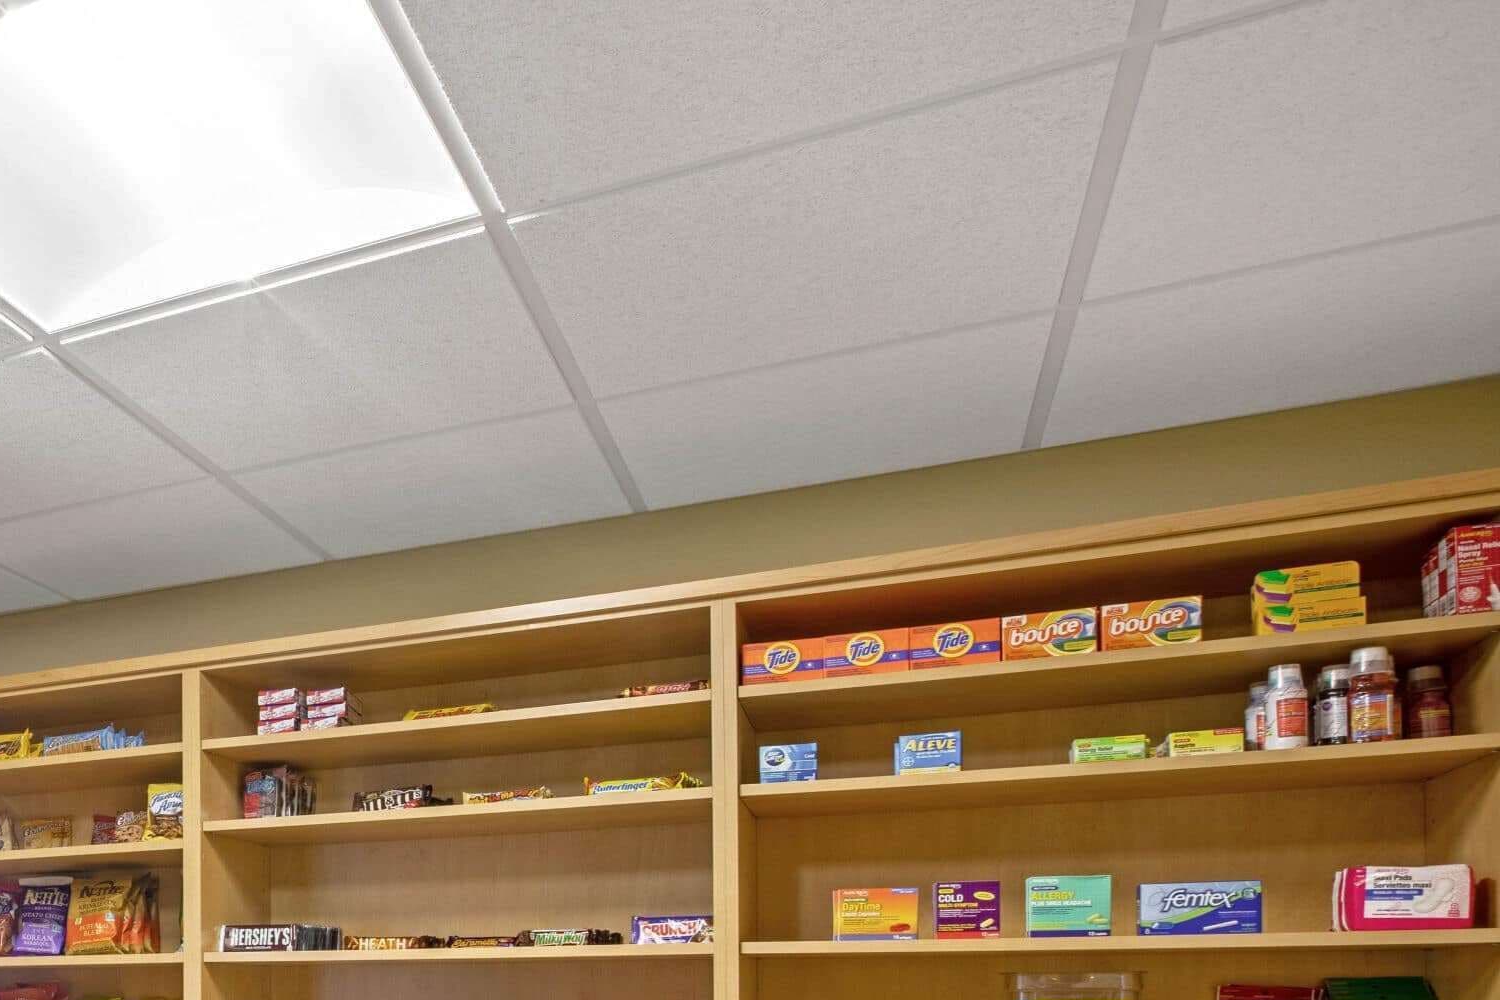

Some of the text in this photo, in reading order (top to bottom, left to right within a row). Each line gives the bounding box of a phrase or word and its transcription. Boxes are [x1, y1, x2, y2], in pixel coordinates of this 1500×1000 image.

[1110, 607, 1185, 635] bounce
[1010, 619, 1080, 646] bounce
[936, 632, 969, 651] Tide
[768, 650, 796, 668] Tide
[849, 641, 880, 660] Tide
[905, 738, 956, 753] ALEVE
[593, 780, 648, 795] Butterfinger
[937, 893, 964, 903] COLD
[1030, 891, 1074, 901] ALLERGY
[1161, 889, 1238, 912] femtex
[842, 901, 881, 913] DayTime
[230, 926, 291, 946] HERSHEY'S
[641, 920, 699, 937] CRUNCH
[358, 937, 407, 950] HEATH
